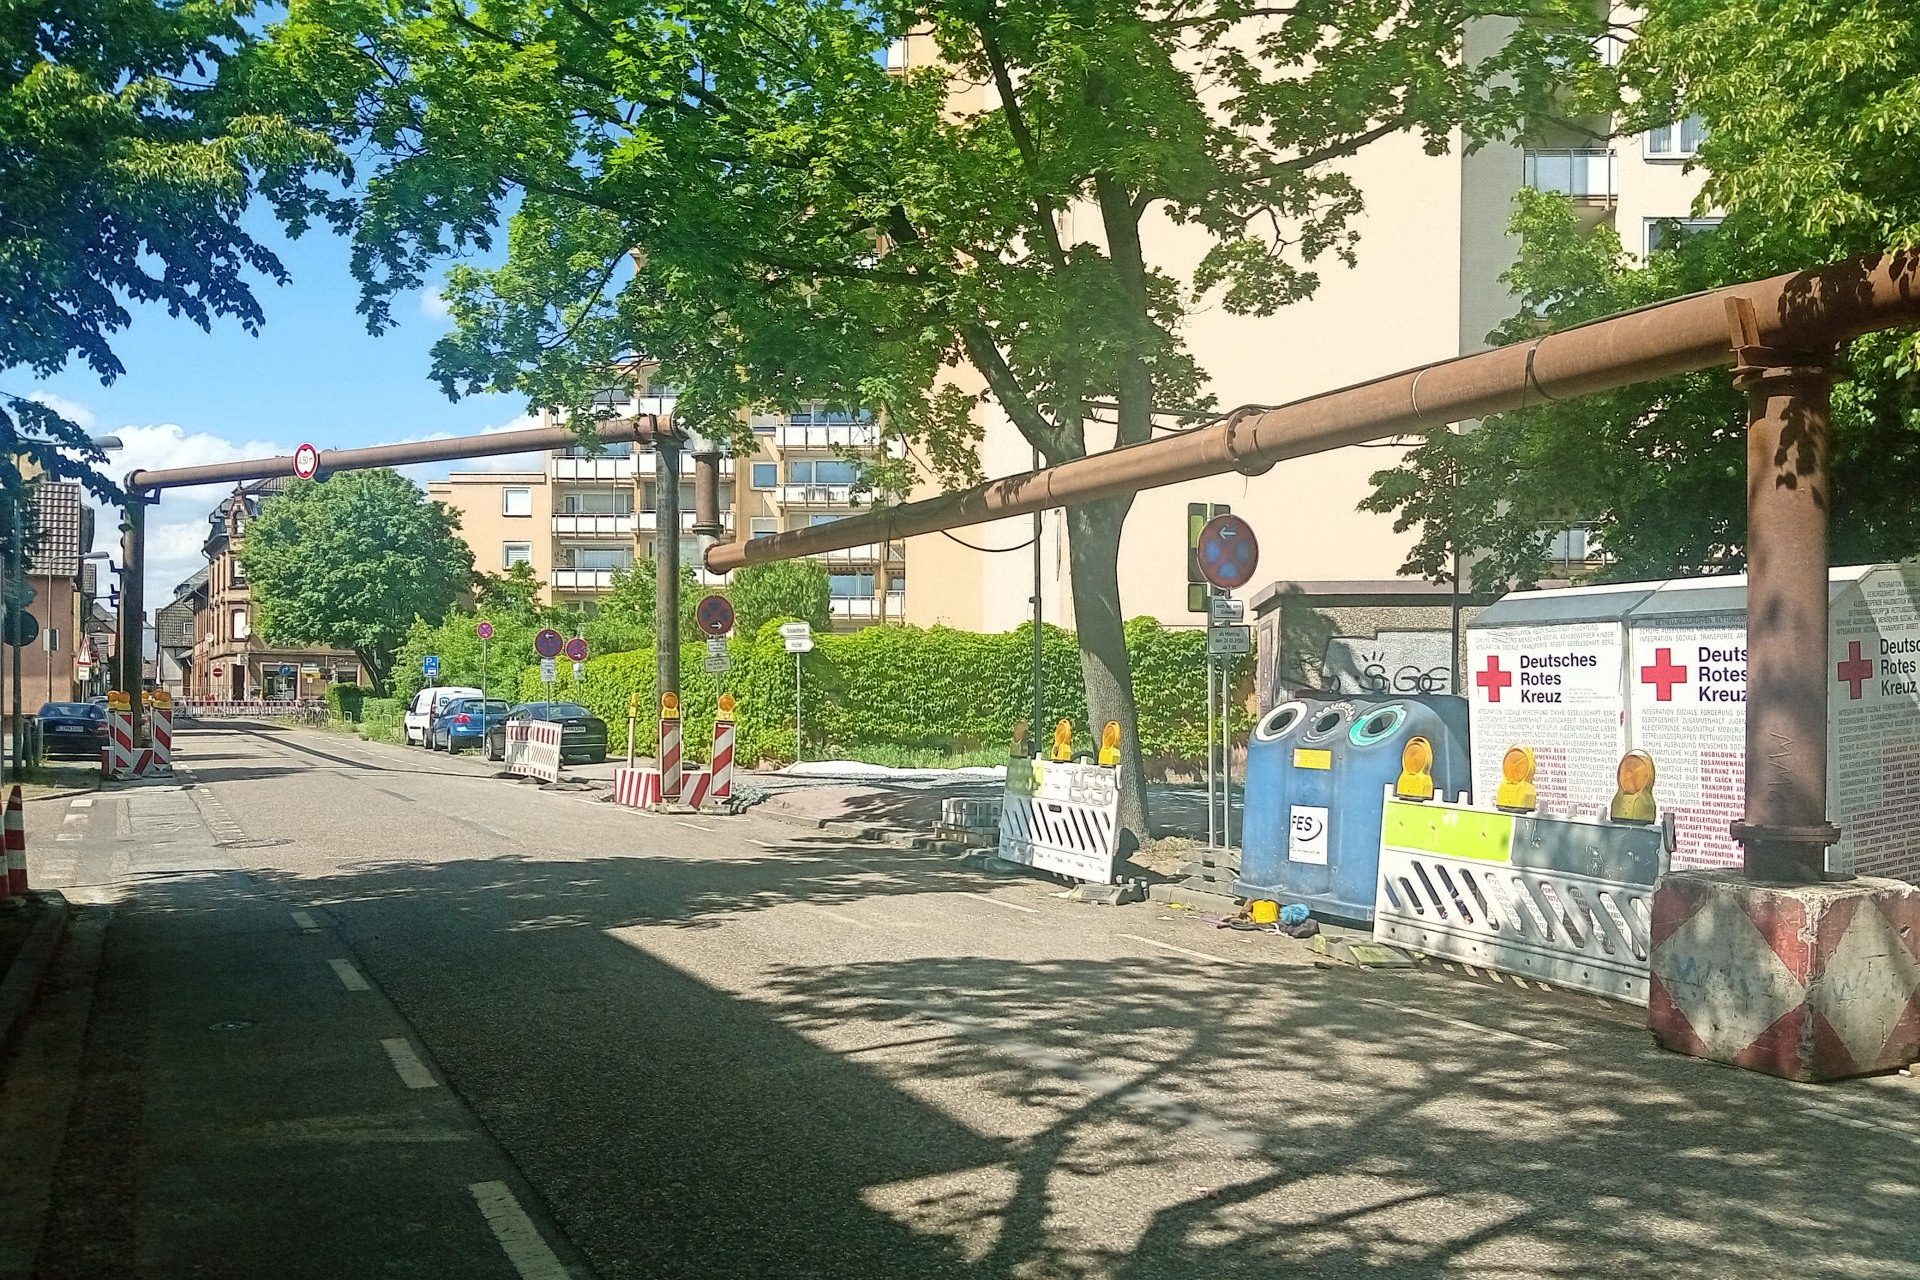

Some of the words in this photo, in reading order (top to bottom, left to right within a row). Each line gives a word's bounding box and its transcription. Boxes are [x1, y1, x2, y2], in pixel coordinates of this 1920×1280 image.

[1521, 653, 1597, 668] Deutsches
[1881, 658, 1916, 676] Rotes
[1521, 672, 1561, 685] Rotes
[1699, 666, 1747, 682] Rotes
[1522, 689, 1562, 703] Kreuz
[1699, 686, 1746, 702] Kreuz
[1881, 680, 1917, 696] Kreuz
[1292, 815, 1313, 832] FES
